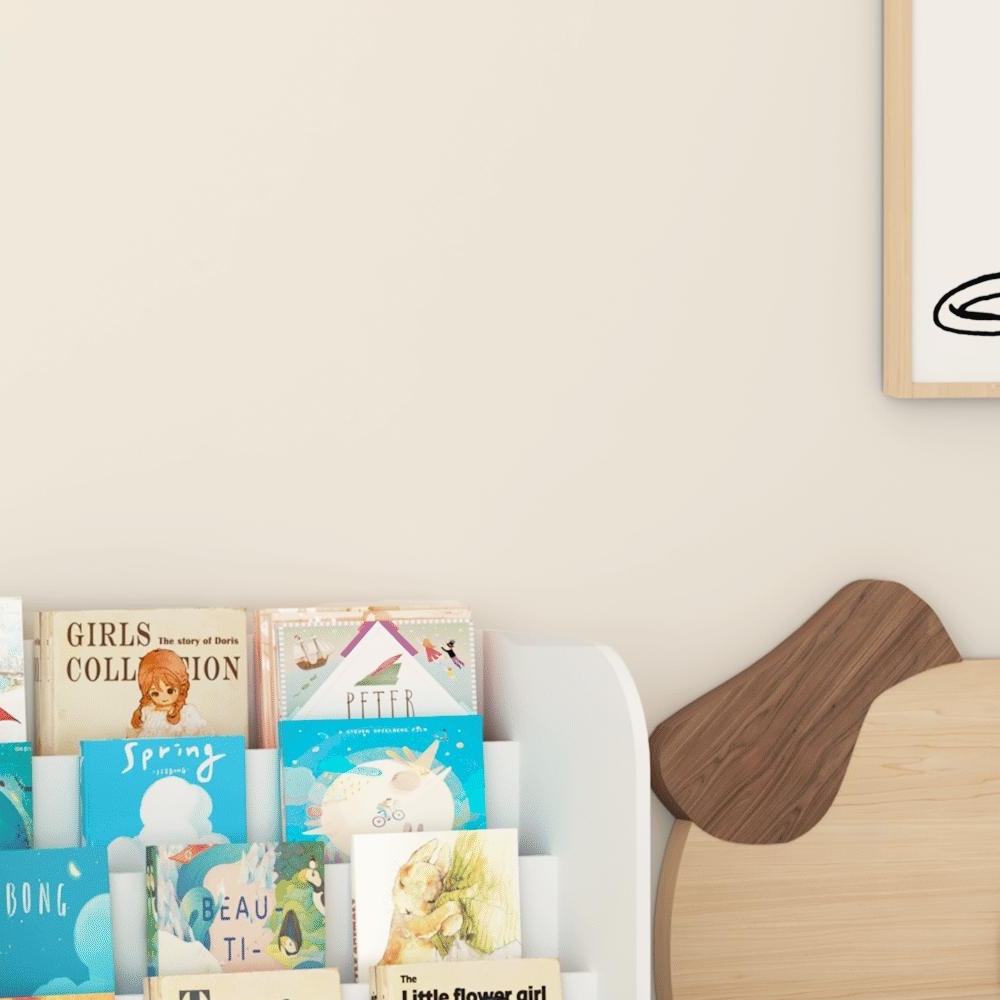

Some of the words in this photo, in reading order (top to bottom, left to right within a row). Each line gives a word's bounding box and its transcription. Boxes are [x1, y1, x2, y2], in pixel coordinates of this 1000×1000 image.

[66, 621, 151, 648] GIRLS
[158, 636, 175, 645] The
[178, 637, 200, 647] story
[203, 636, 212, 645] of
[215, 636, 240, 645] Doris
[66, 656, 240, 682] COLLION
[121, 741, 227, 783] Spring
[202, 895, 284, 921] BEAU-
[224, 936, 261, 961] TI-
[399, 975, 417, 984] The
